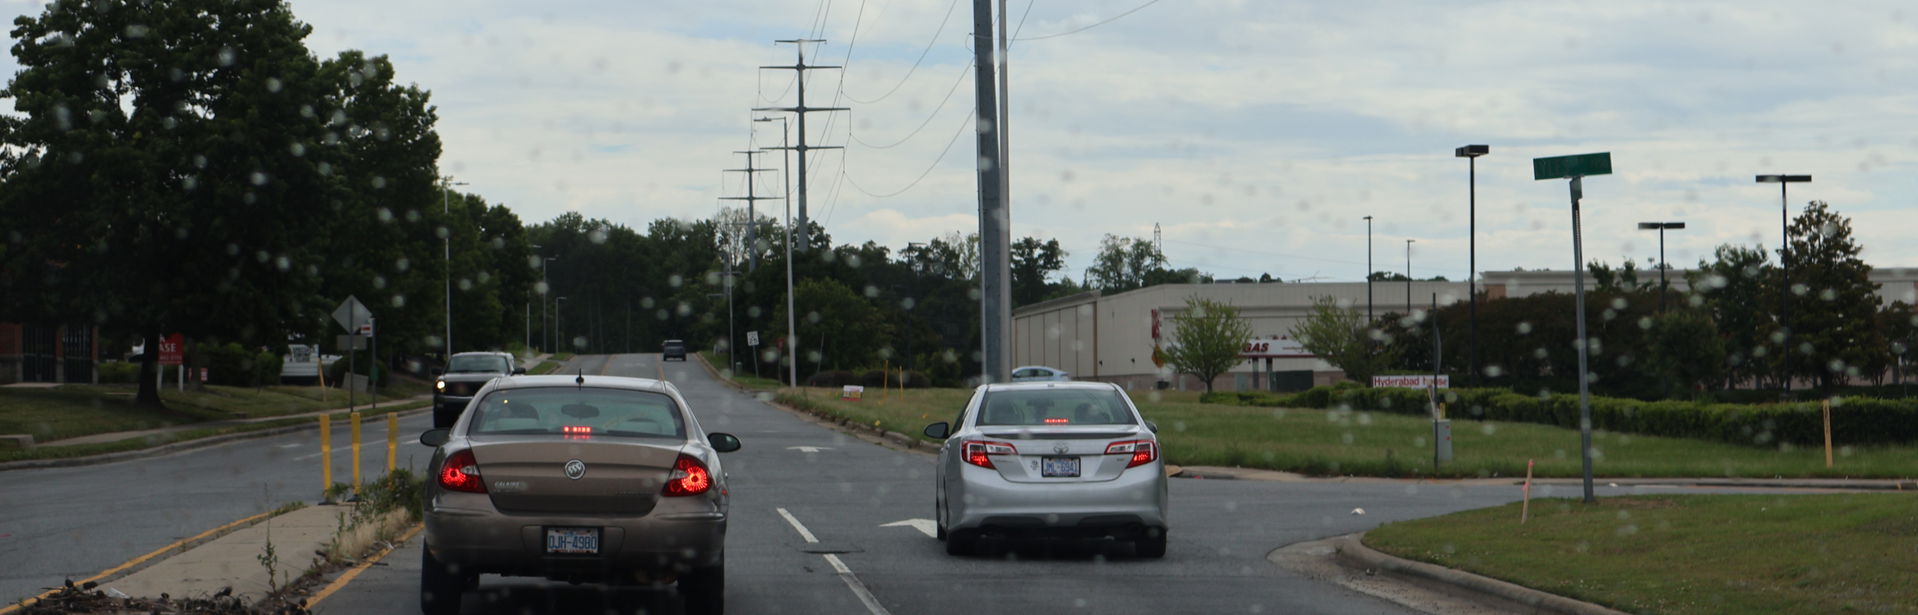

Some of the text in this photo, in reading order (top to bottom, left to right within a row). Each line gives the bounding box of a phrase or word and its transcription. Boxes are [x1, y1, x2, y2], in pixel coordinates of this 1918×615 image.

[159, 343, 177, 352] ASE
[1242, 343, 1269, 352] GAS
[1374, 376, 1447, 388] Hyderabad hse
[548, 535, 597, 549] DJH-4980
